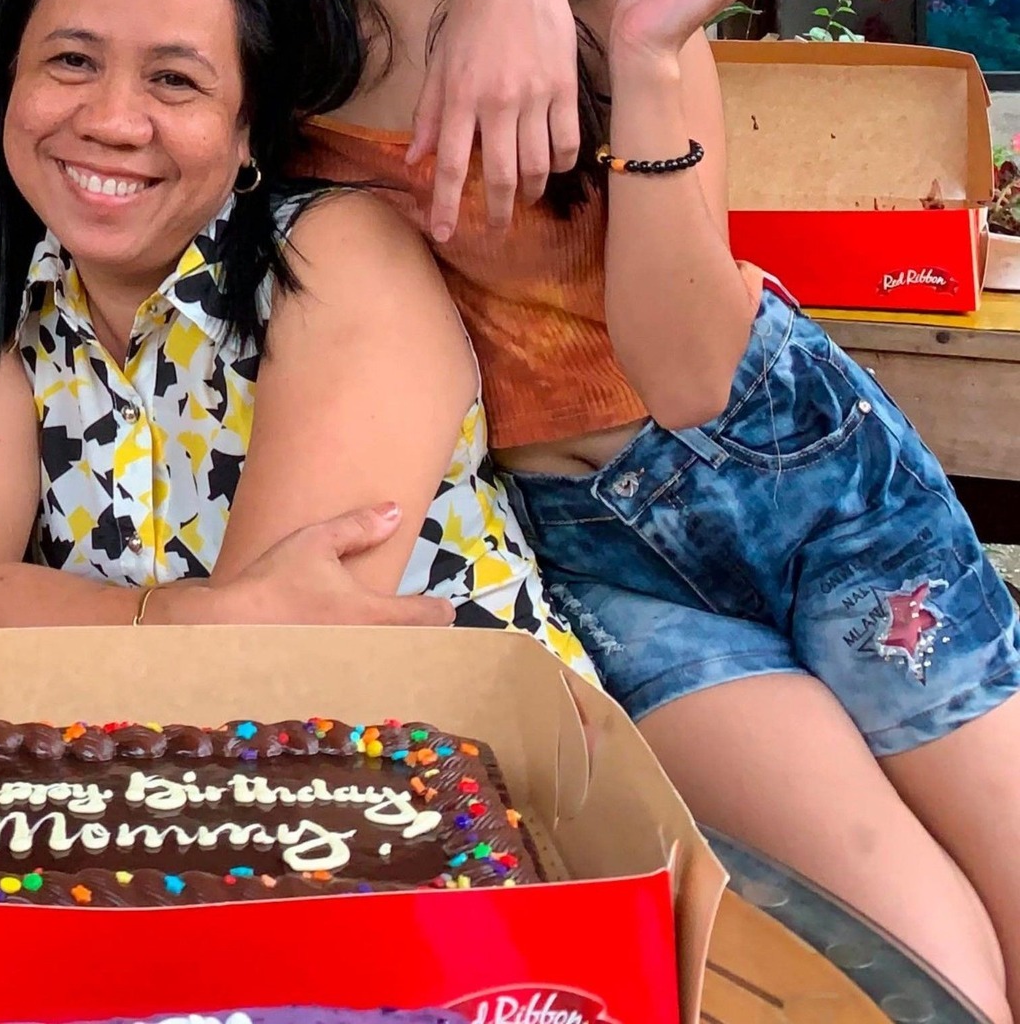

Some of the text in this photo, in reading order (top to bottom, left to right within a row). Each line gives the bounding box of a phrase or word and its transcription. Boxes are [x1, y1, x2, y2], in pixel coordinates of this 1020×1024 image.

[883, 269, 947, 290] Red Ribbon
[494, 992, 584, 1024] Ribbon
